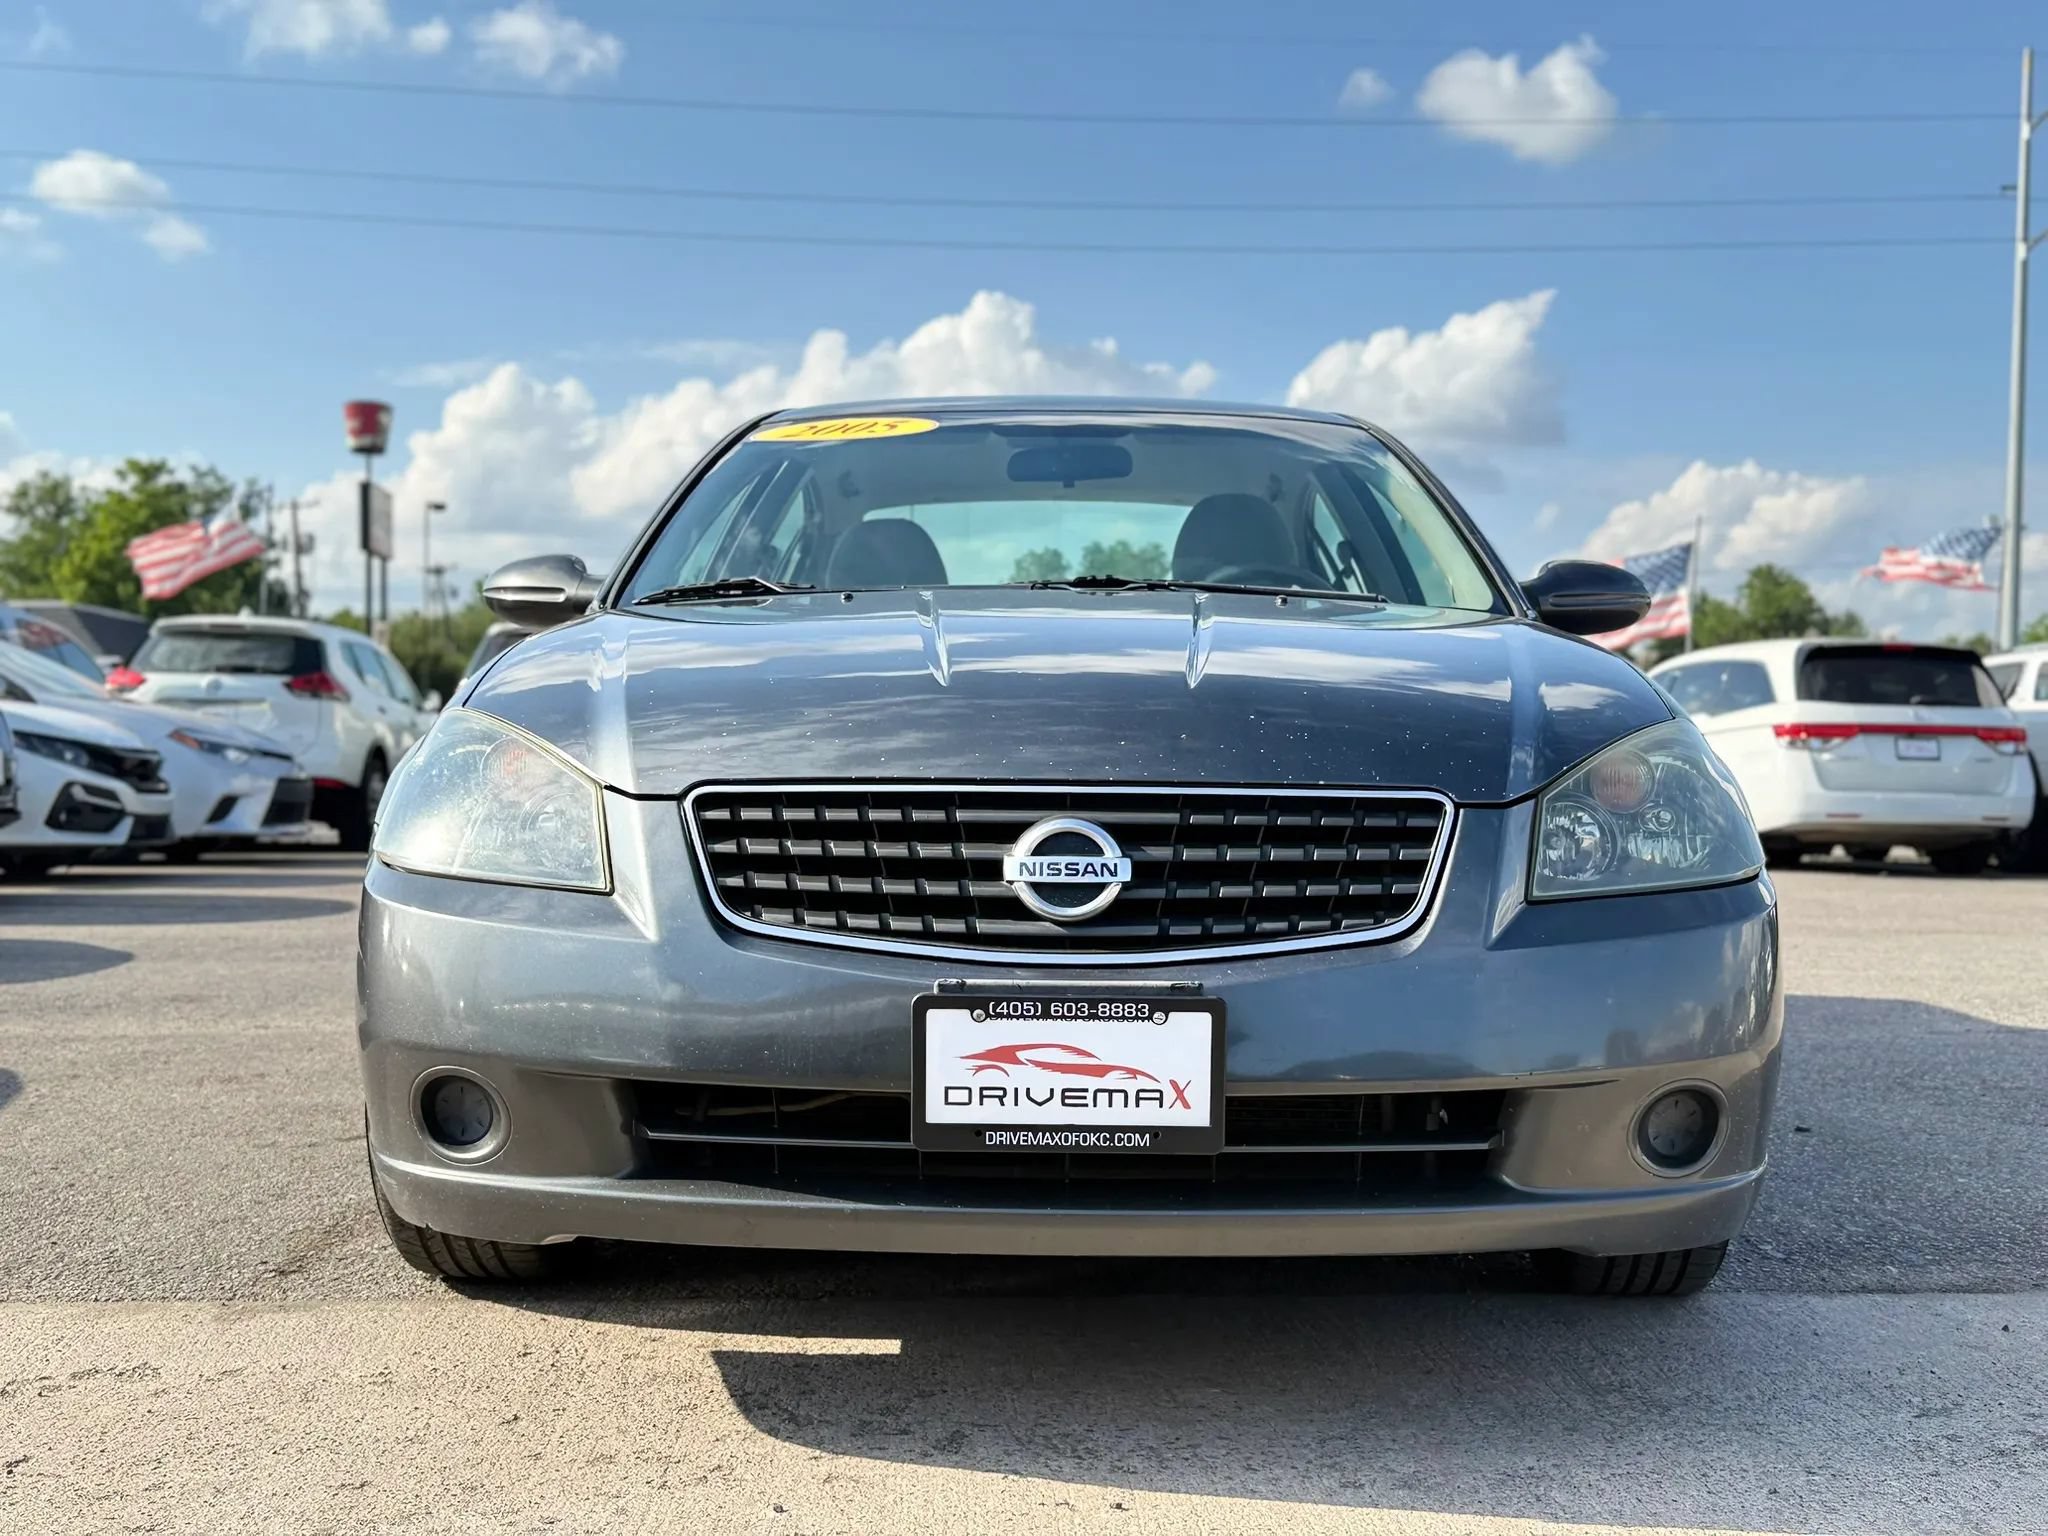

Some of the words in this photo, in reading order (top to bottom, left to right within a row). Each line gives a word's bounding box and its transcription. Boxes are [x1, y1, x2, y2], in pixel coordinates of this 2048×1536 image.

[1019, 861, 1118, 878] NISSAN
[988, 1001, 1042, 1016] (405)
[1050, 1002, 1150, 1018] 603-8883
[944, 1079, 1192, 1110] DRIVEMAX
[985, 1131, 1150, 1147] DRIVEMAXOFOKC.COM
